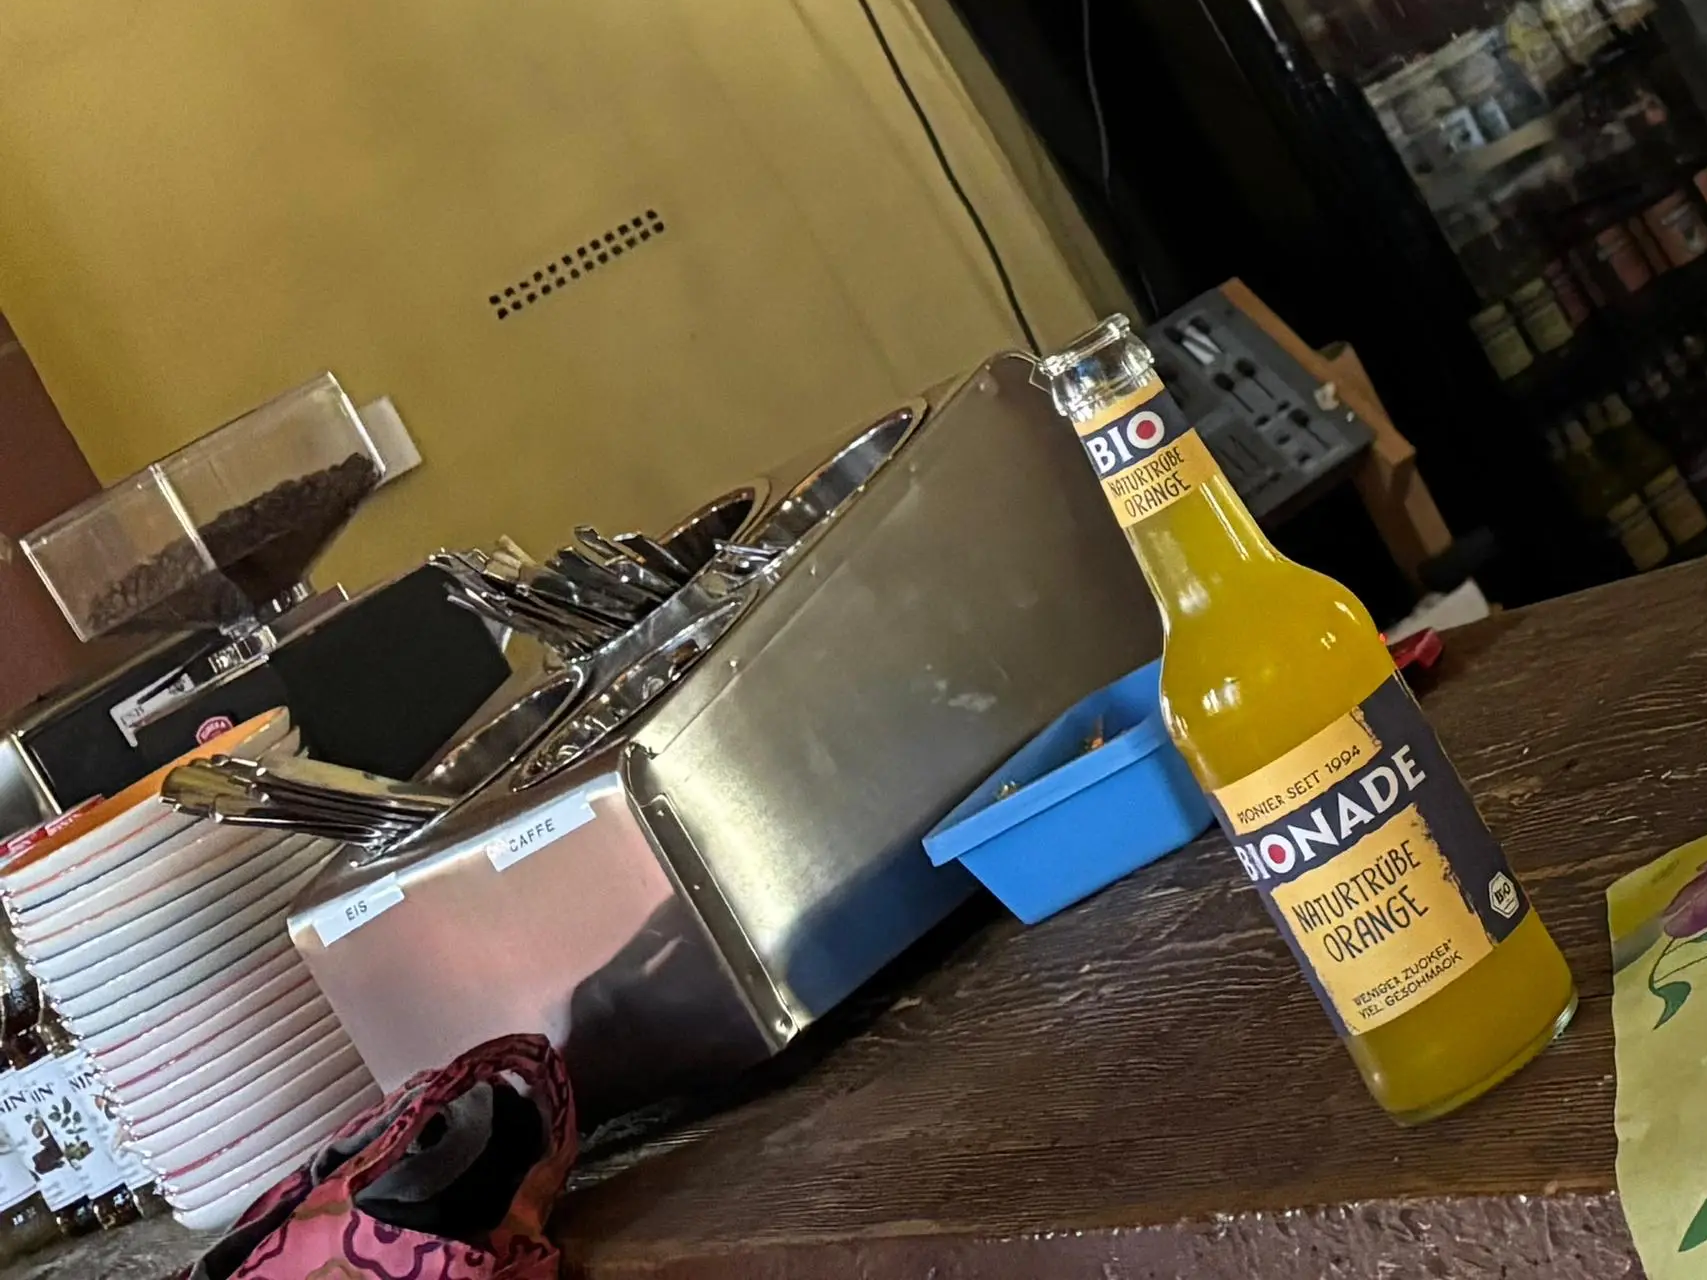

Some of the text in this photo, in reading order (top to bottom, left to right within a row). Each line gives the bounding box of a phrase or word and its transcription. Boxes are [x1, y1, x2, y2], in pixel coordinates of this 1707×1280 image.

[1086, 410, 1165, 474] BIO
[1124, 471, 1191, 518] ORANGE
[1287, 769, 1320, 799] SEIT
[1324, 745, 1361, 774] 1994
[509, 818, 555, 853] CAFFE
[1234, 744, 1427, 881] BIONADE
[345, 900, 368, 921] EIS
[1292, 839, 1421, 933] NATURTRÜBE
[1323, 885, 1429, 963] ORANGE
